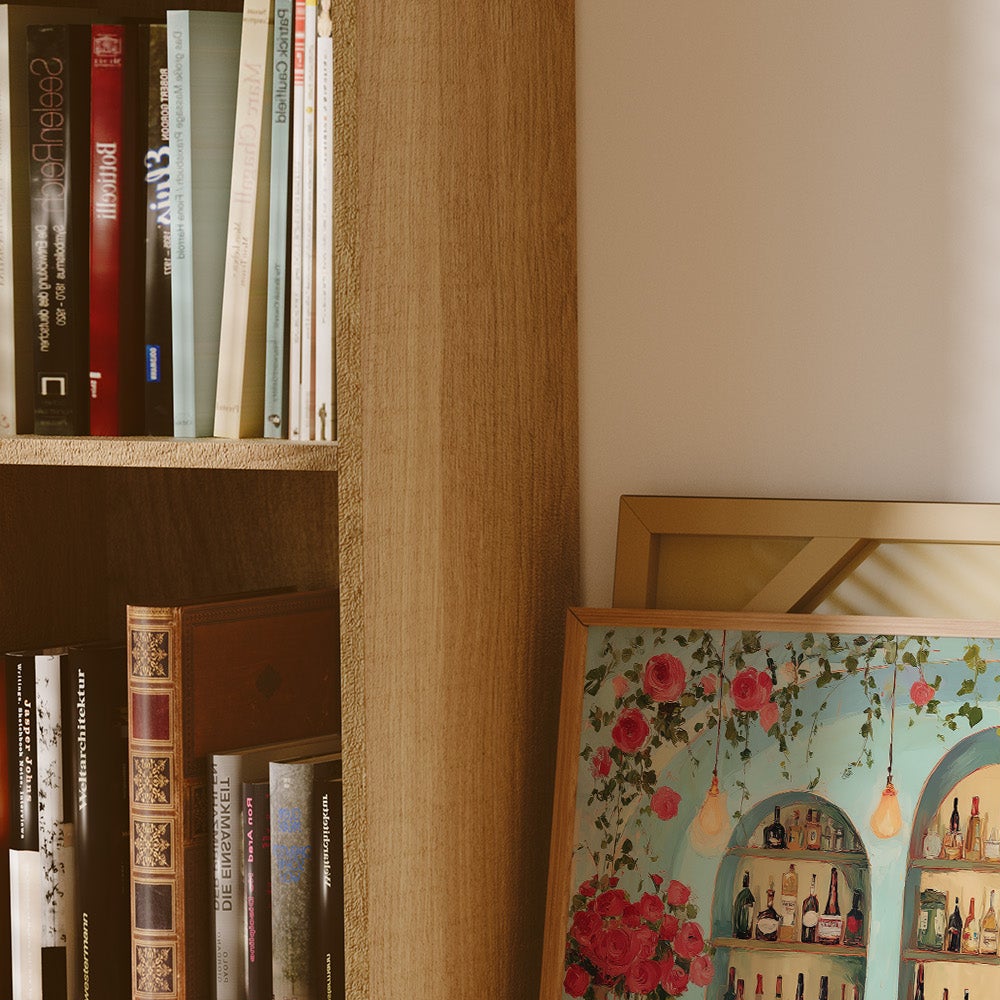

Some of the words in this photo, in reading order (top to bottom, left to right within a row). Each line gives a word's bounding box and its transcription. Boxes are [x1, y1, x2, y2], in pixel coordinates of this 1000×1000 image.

[22, 700, 32, 751] Jasper
[76, 668, 89, 811] Weltarchitektur
[24, 756, 33, 803] Johns
